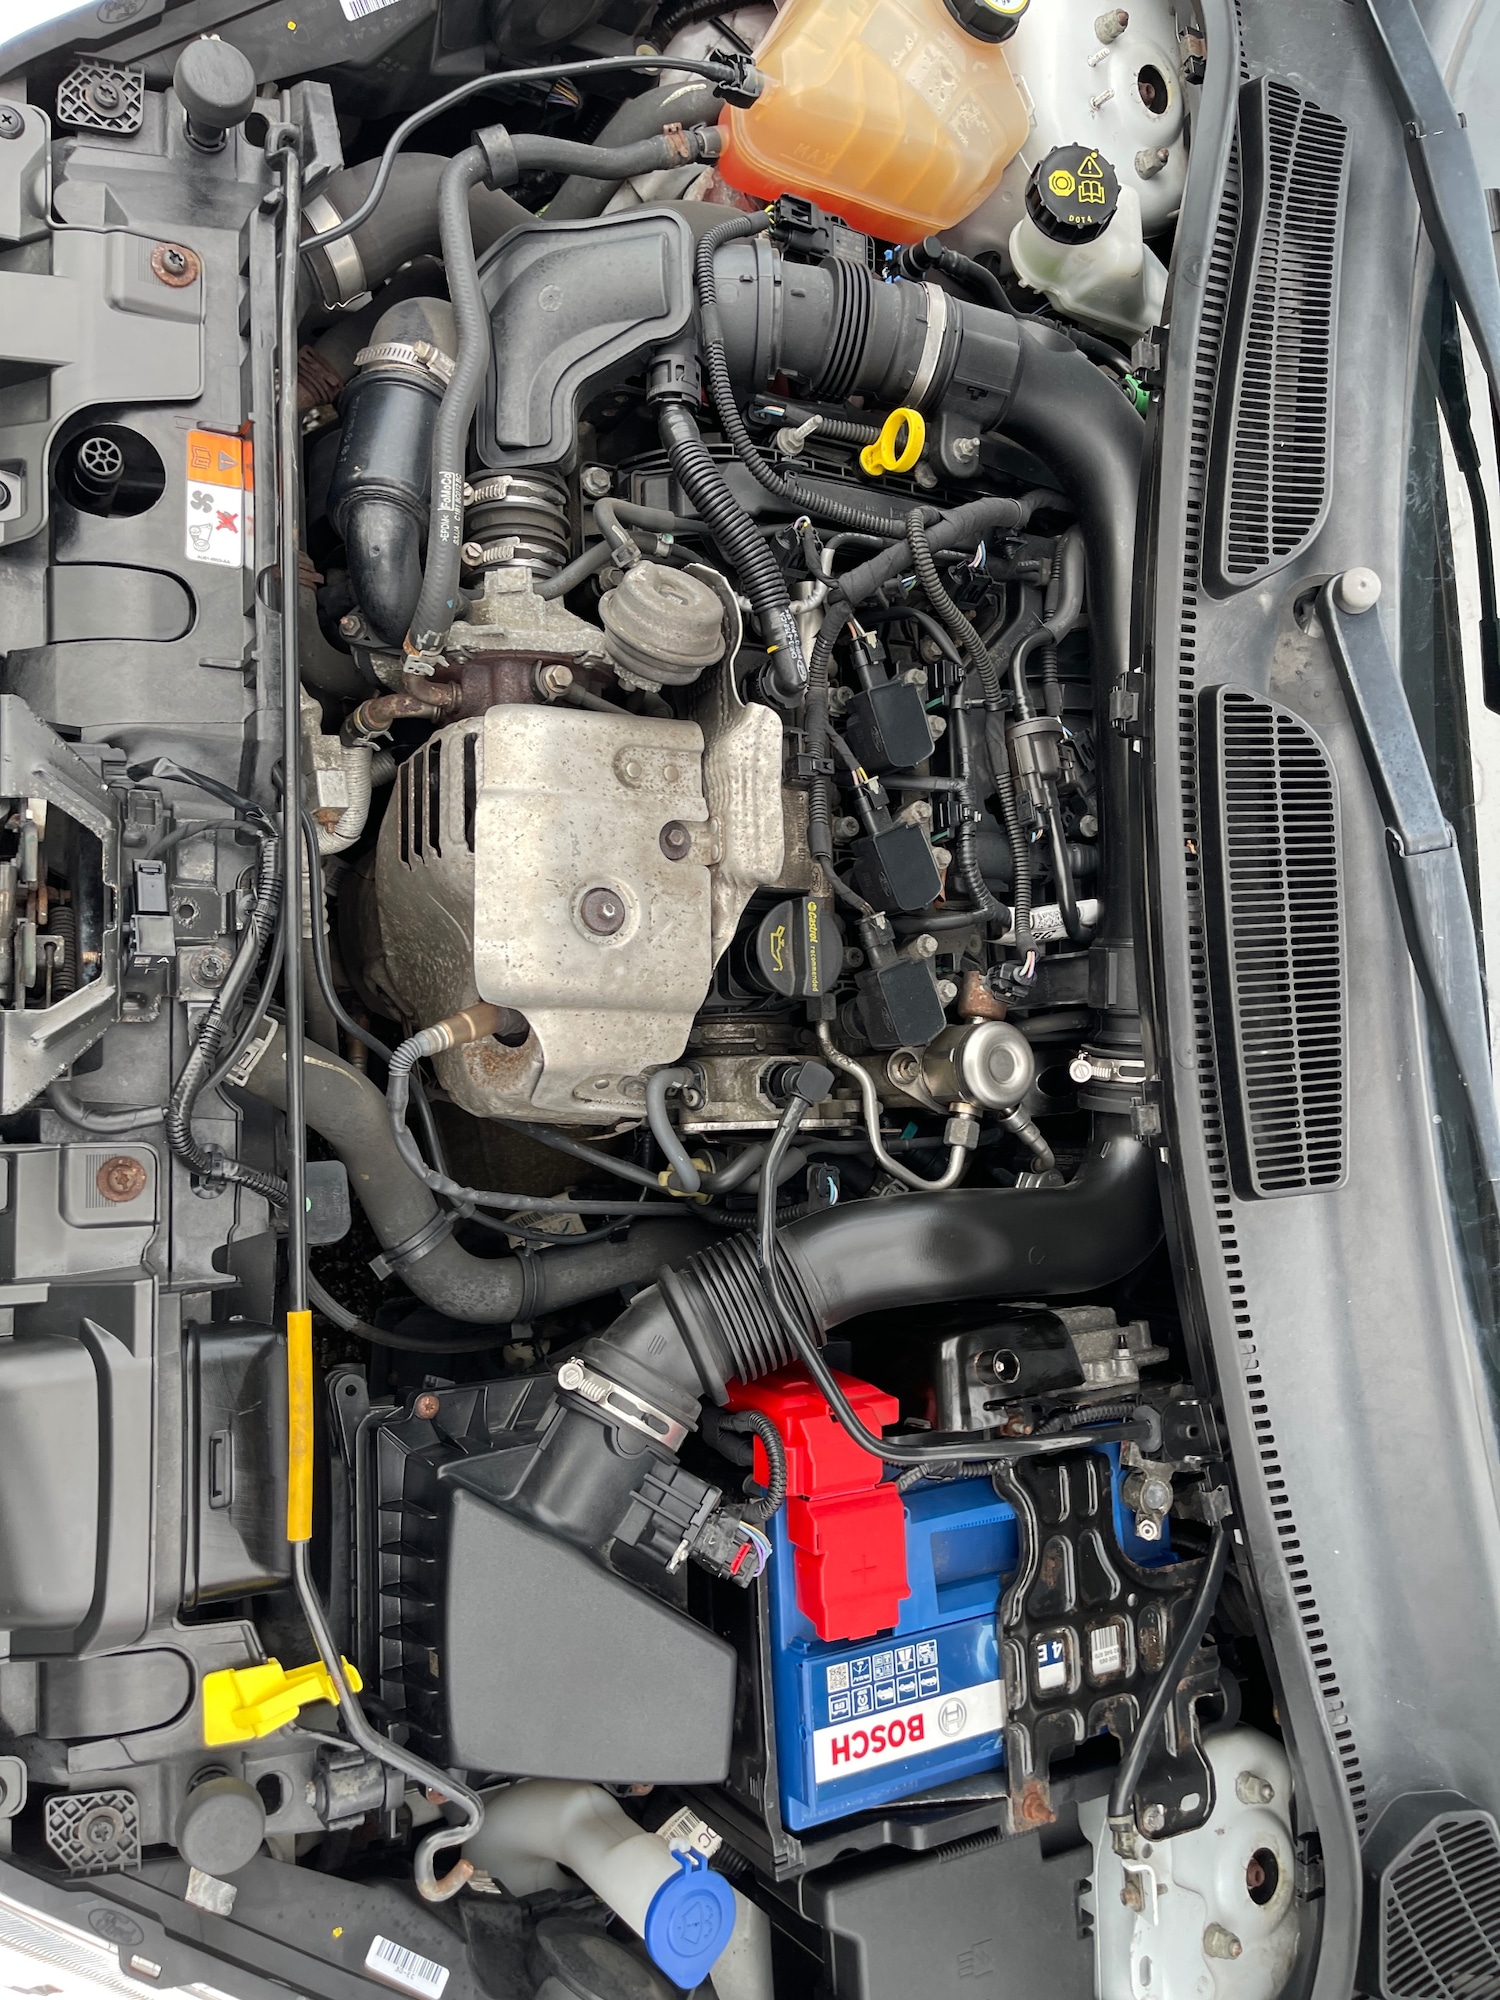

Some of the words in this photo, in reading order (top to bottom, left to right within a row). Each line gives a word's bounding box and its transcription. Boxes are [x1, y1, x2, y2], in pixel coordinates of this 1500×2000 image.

[793, 141, 836, 169] MAX
[440, 473, 452, 508] FoMoCo
[808, 911, 819, 943] Castrol
[809, 945, 819, 992] recommended
[830, 1712, 925, 1766] BOSCH
